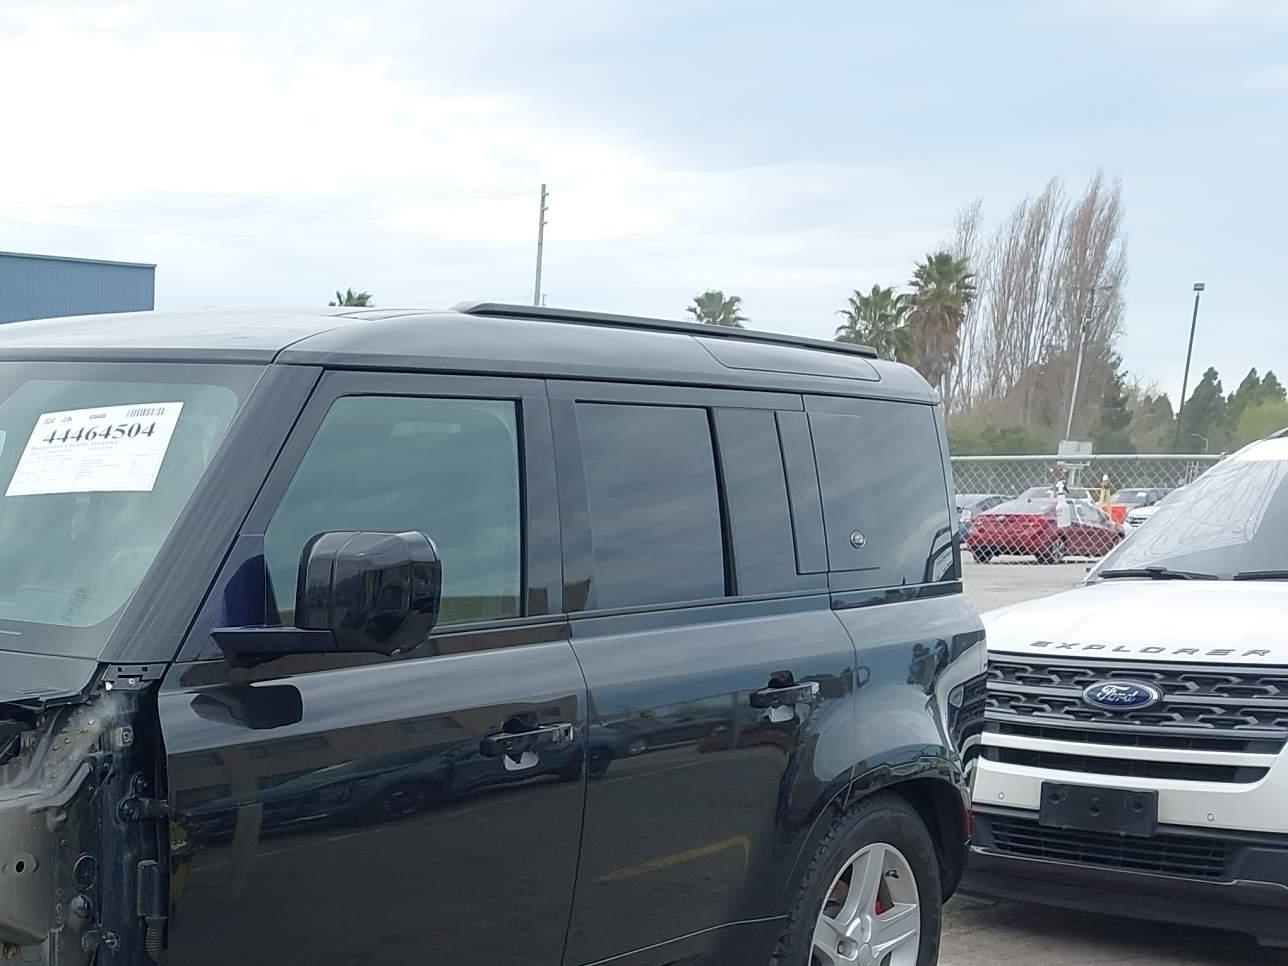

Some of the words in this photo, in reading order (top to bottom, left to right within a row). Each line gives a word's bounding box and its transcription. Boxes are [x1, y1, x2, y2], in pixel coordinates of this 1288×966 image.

[43, 421, 157, 445] 44464504
[1029, 640, 1272, 657] EXPLORER
[1095, 685, 1138, 704] Ford
